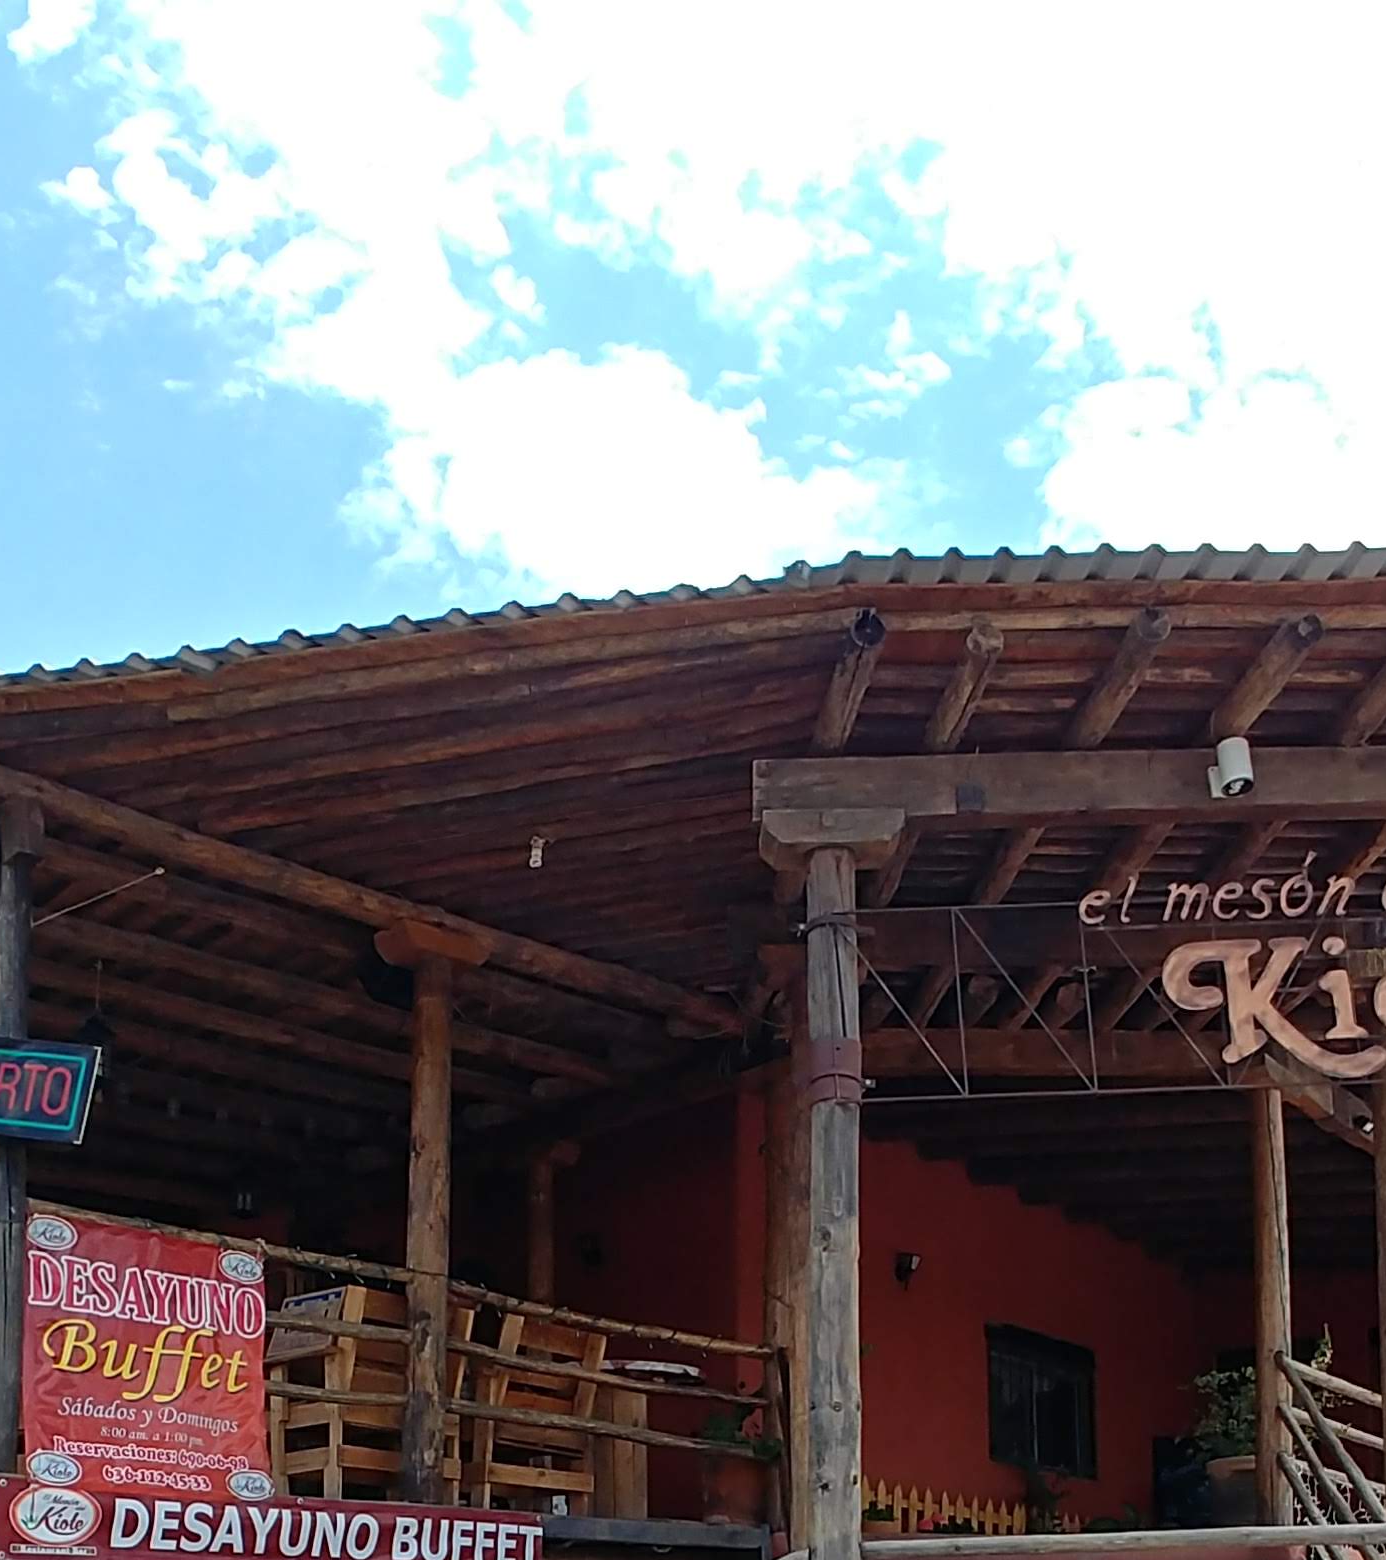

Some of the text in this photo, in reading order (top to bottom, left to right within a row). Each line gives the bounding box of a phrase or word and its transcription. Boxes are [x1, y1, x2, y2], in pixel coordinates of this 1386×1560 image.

[1078, 872, 1139, 925] el
[1162, 850, 1356, 922] mesón
[27, 1250, 266, 1339] DESAYUNO
[42, 1318, 248, 1403] Buffet
[57, 1397, 239, 1437] Sábados y Domingos
[100, 1426, 127, 1439] 8:00
[165, 1431, 188, 1444] 1:00
[53, 1435, 249, 1470] Reservaciones: 690-06-98
[109, 1498, 381, 1560] DESAYUNO
